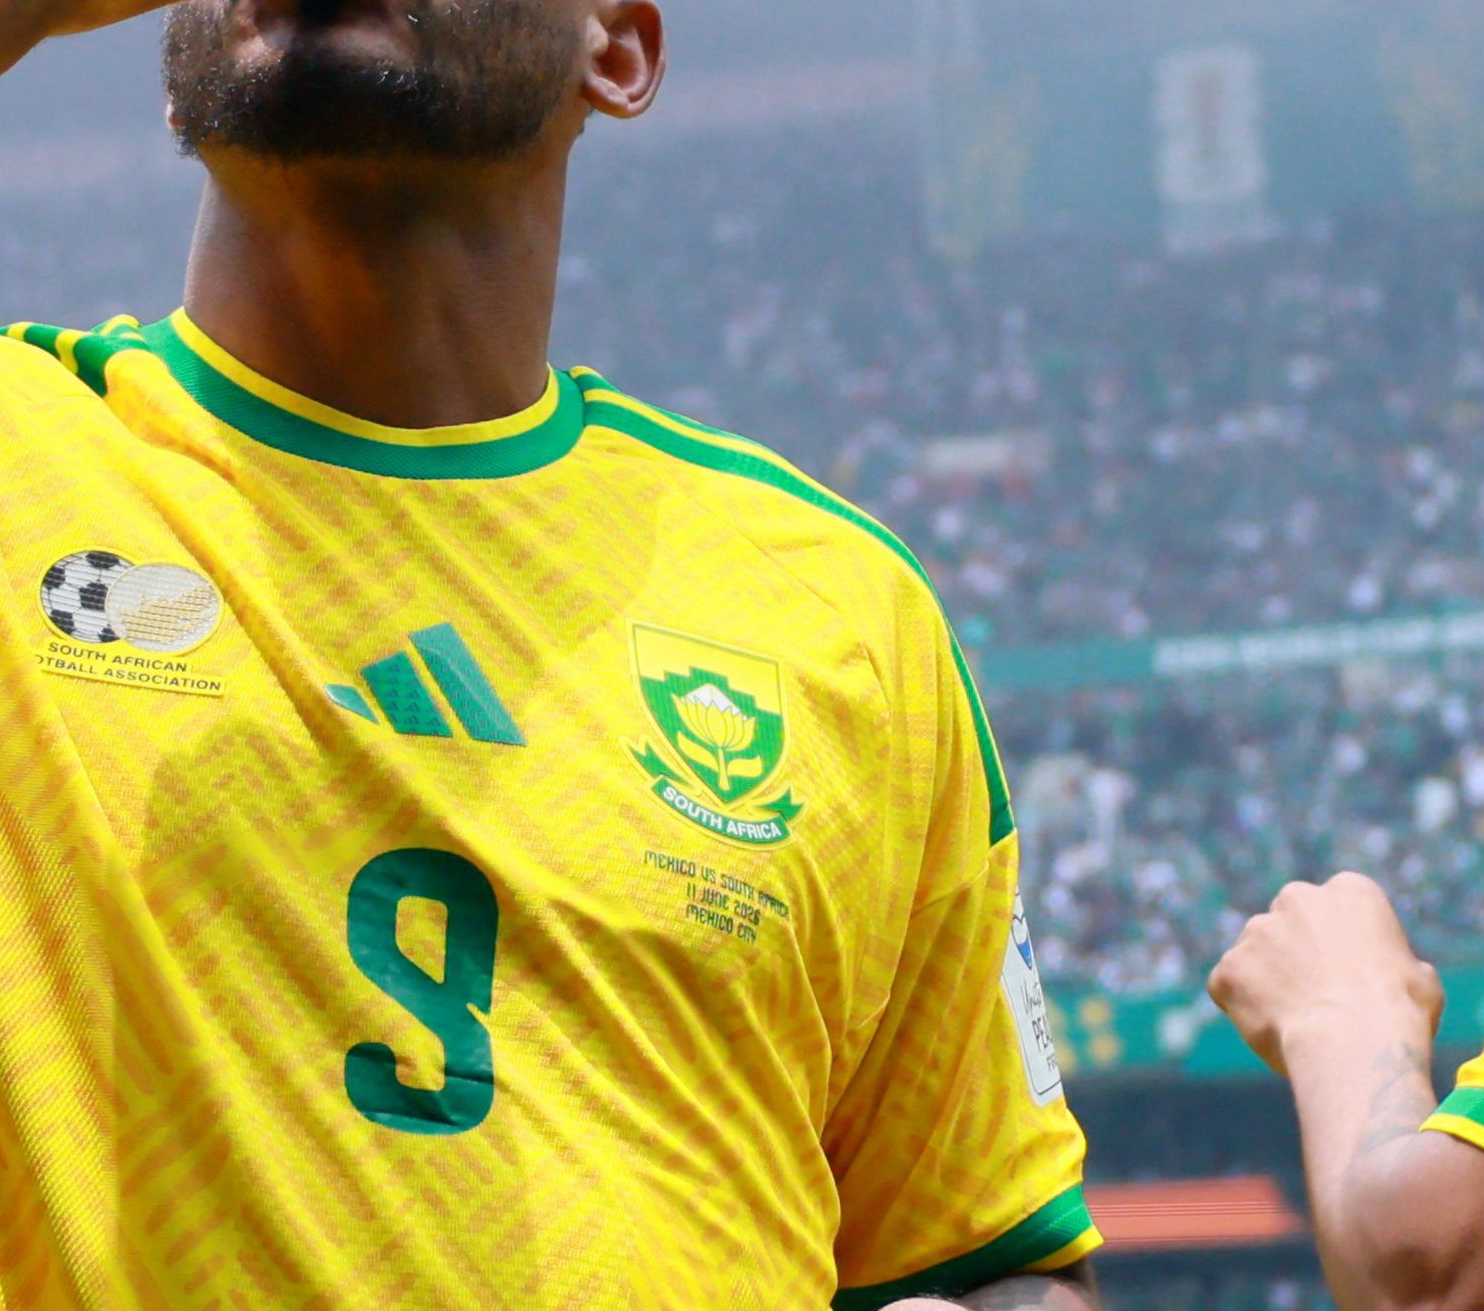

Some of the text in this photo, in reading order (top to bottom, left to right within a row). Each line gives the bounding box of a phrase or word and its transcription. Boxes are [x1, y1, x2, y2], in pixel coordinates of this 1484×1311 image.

[48, 641, 188, 673] SOUTH AFRICAN
[103, 667, 222, 691] ASSOCIATION
[662, 786, 782, 840] SOUTH AFRICA
[644, 849, 697, 878] MEXICO
[720, 873, 755, 900] SOUTH
[686, 904, 758, 946] MEXICO CITY
[701, 884, 730, 910] JUNE
[734, 900, 762, 925] 2026
[343, 846, 499, 1136] 9
